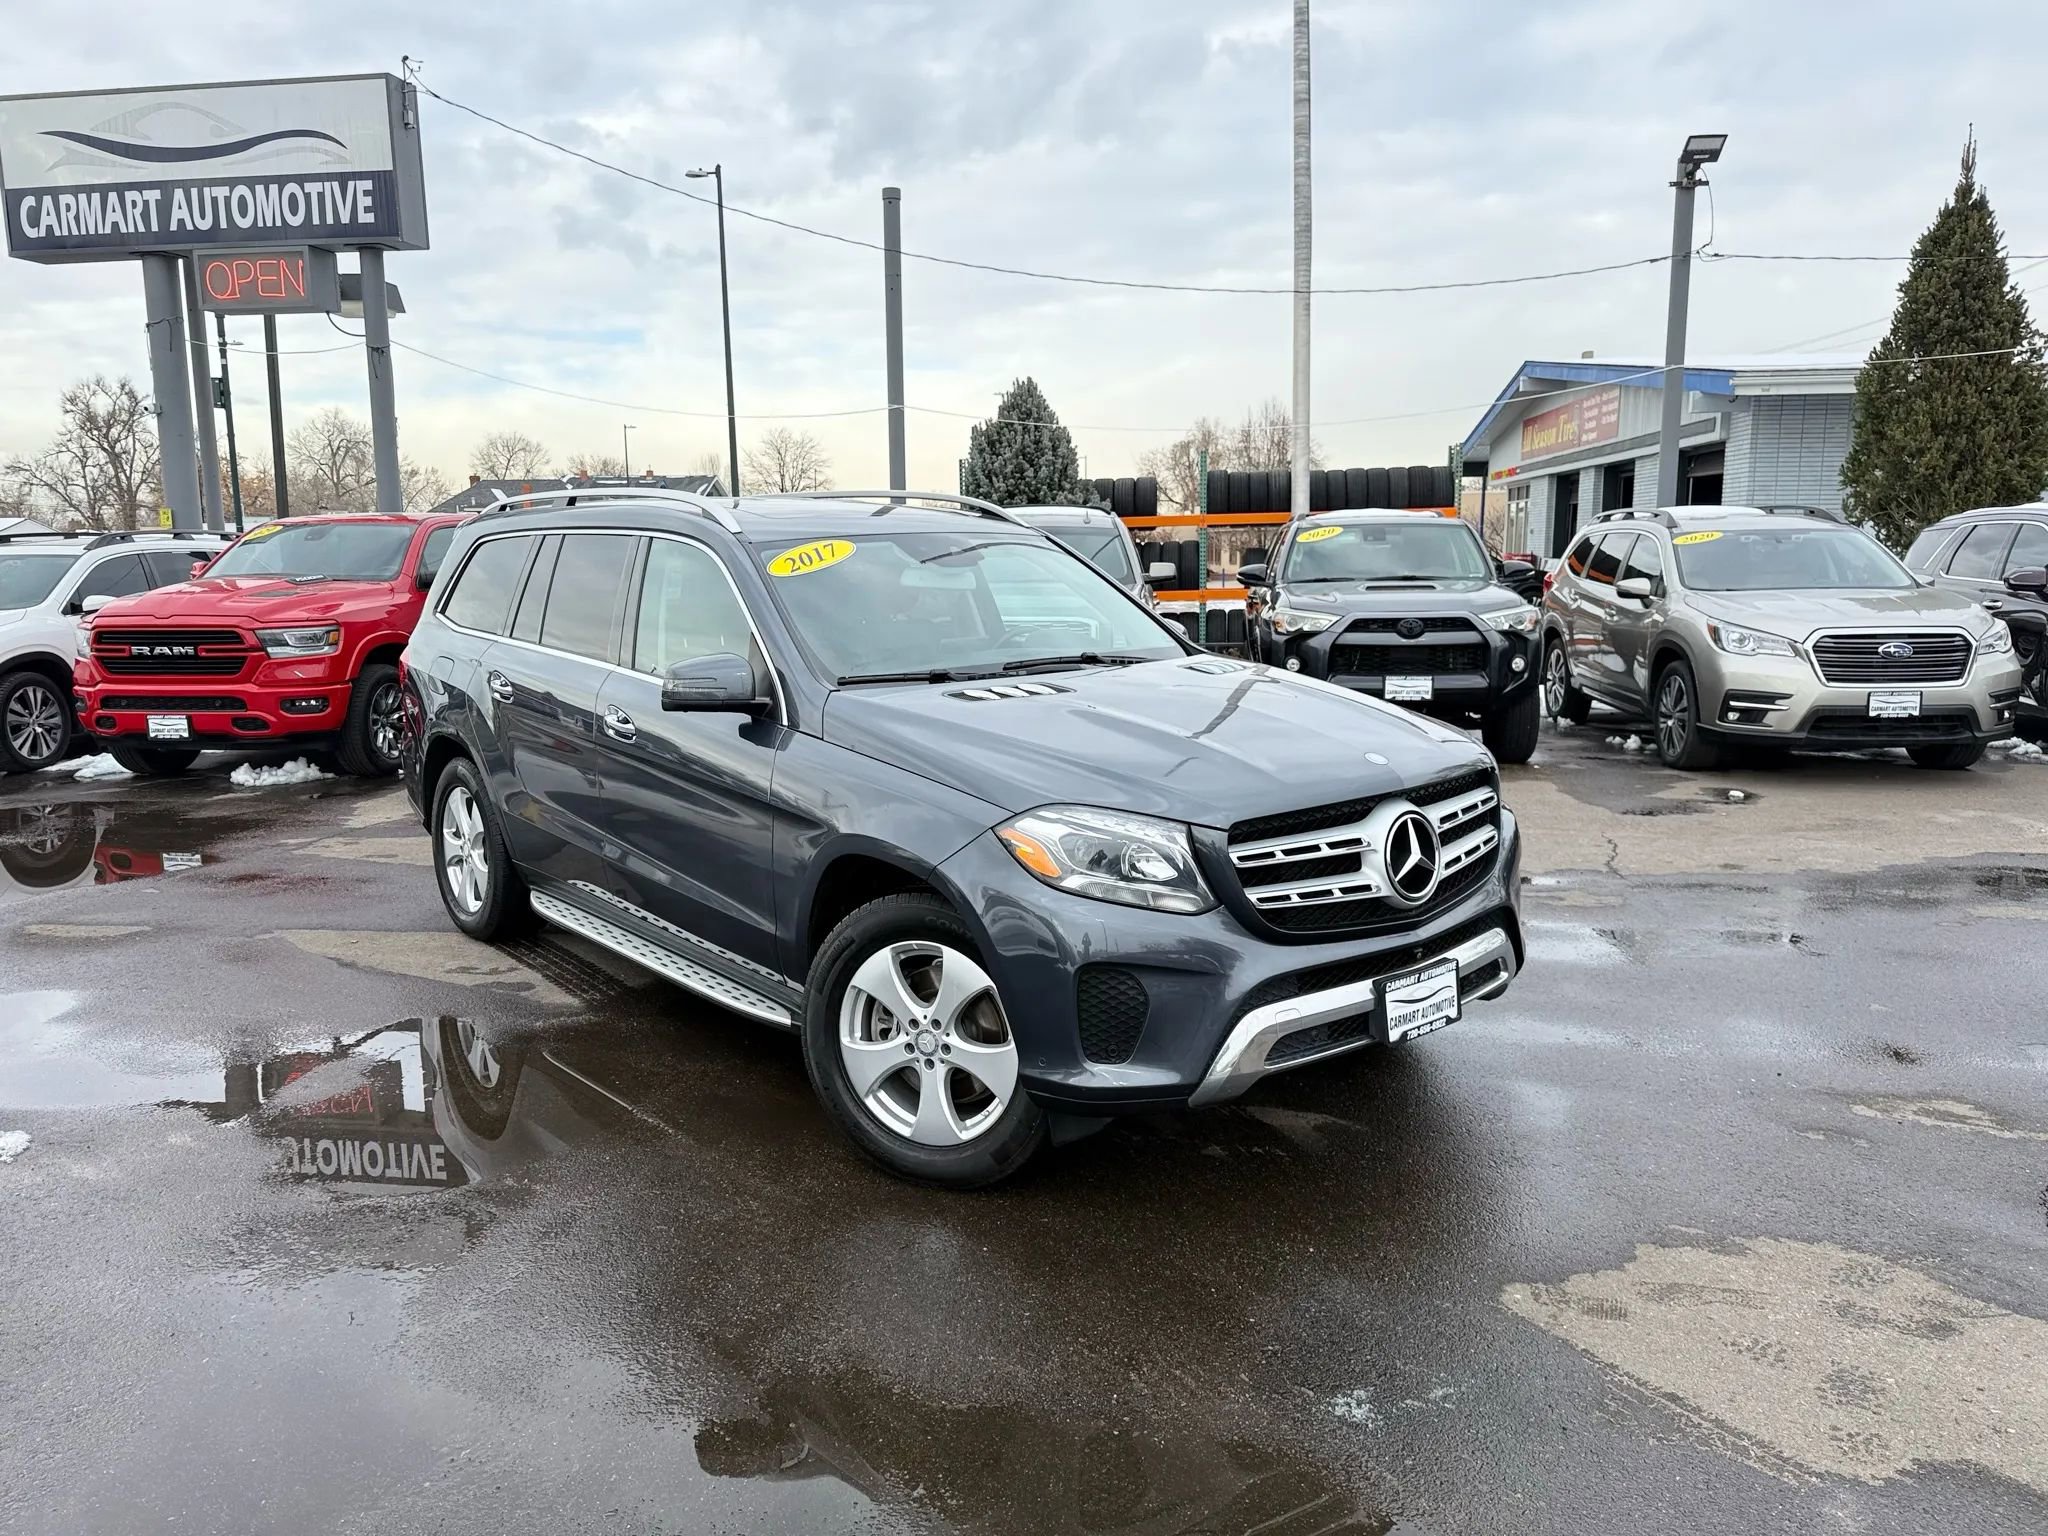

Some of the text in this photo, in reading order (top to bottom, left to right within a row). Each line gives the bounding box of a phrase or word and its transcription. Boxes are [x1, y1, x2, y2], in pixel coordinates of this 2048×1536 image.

[20, 179, 375, 239] CARMART AUTOMOTIVE
[205, 258, 305, 300] OPEN
[784, 543, 835, 573] 2017
[130, 645, 195, 656] RAM
[1386, 960, 1458, 992] CARMART AUTOMOTIVE
[1389, 995, 1455, 1031] CARMART AUTOMOTIVE
